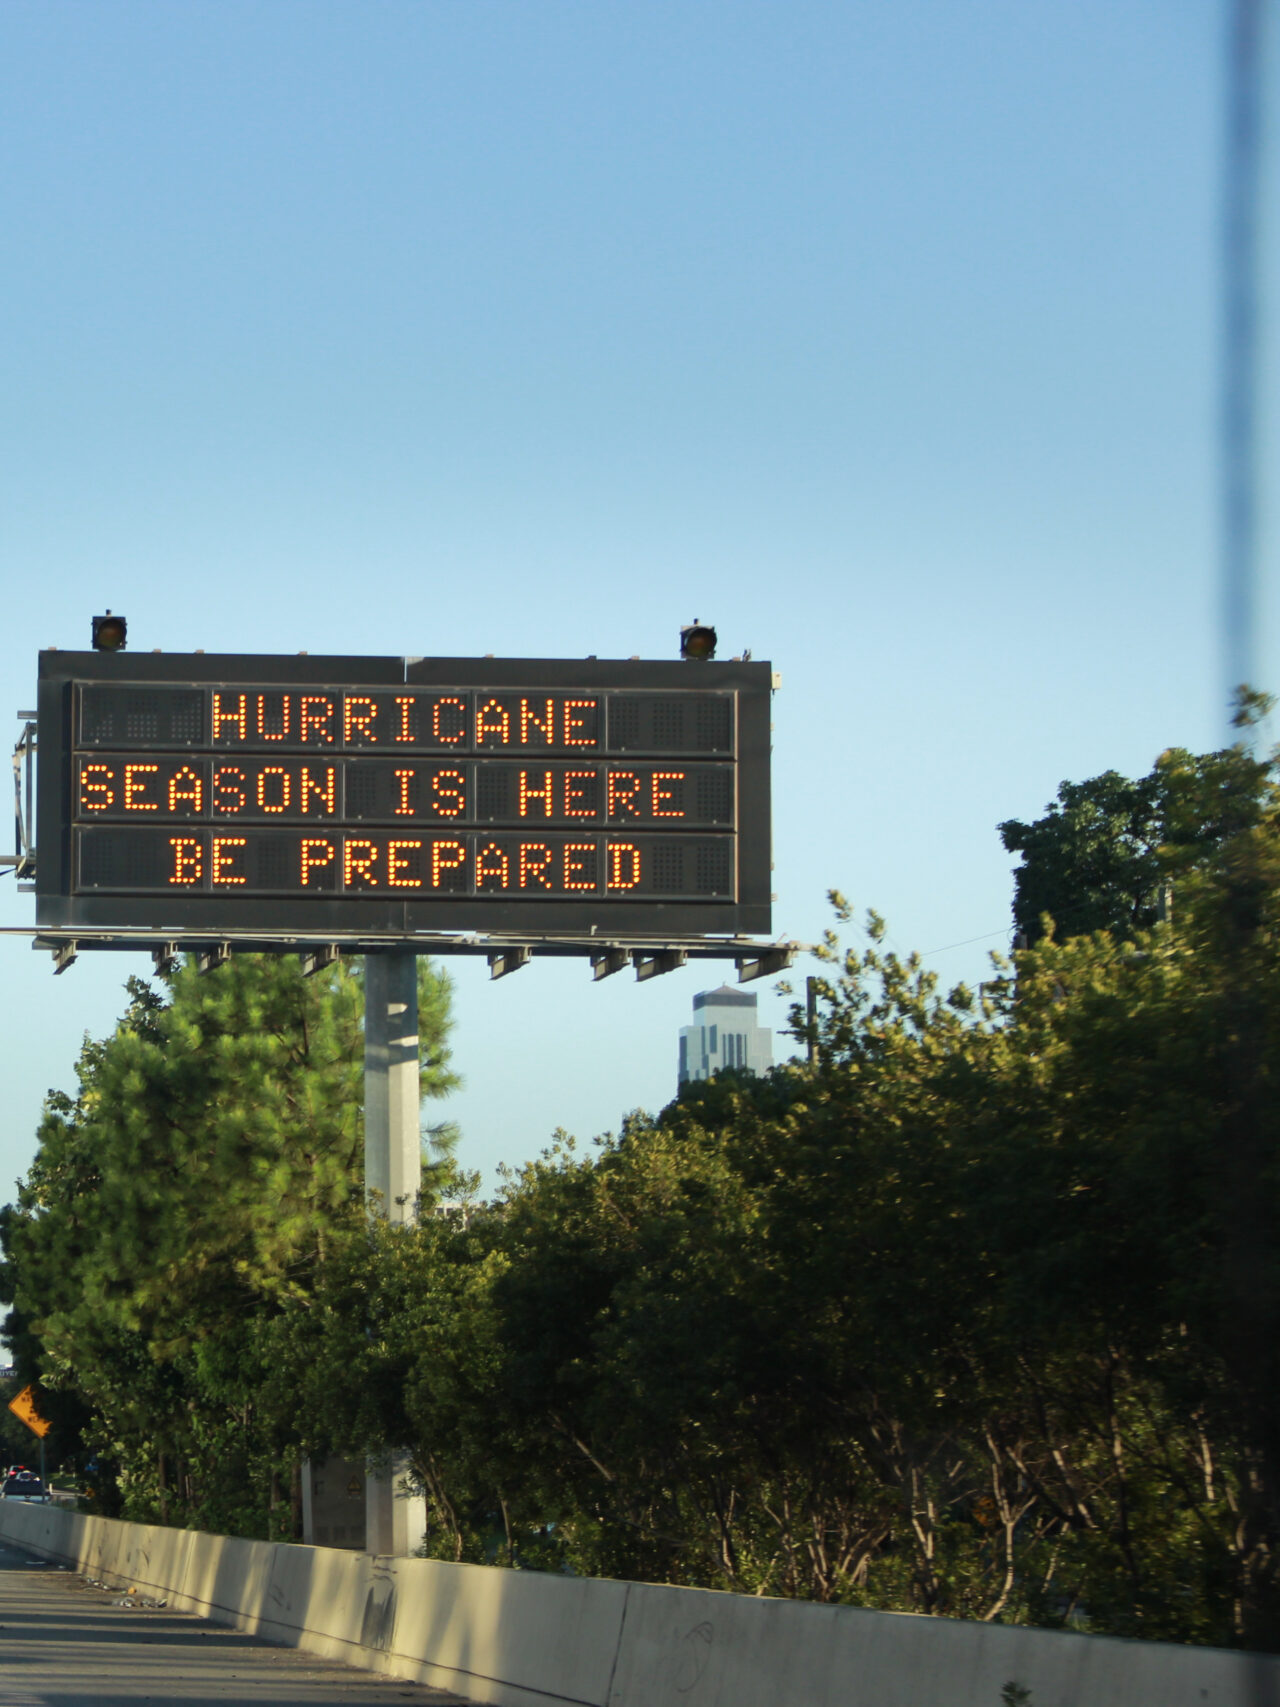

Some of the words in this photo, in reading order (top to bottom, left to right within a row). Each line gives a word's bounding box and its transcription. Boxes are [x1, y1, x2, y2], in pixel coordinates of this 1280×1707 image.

[212, 694, 596, 745] HURRICANE
[80, 764, 335, 813] SEASON
[394, 769, 465, 816] IS
[519, 770, 685, 817] HERE
[169, 837, 247, 885] BE
[301, 838, 641, 890] PREPARED
